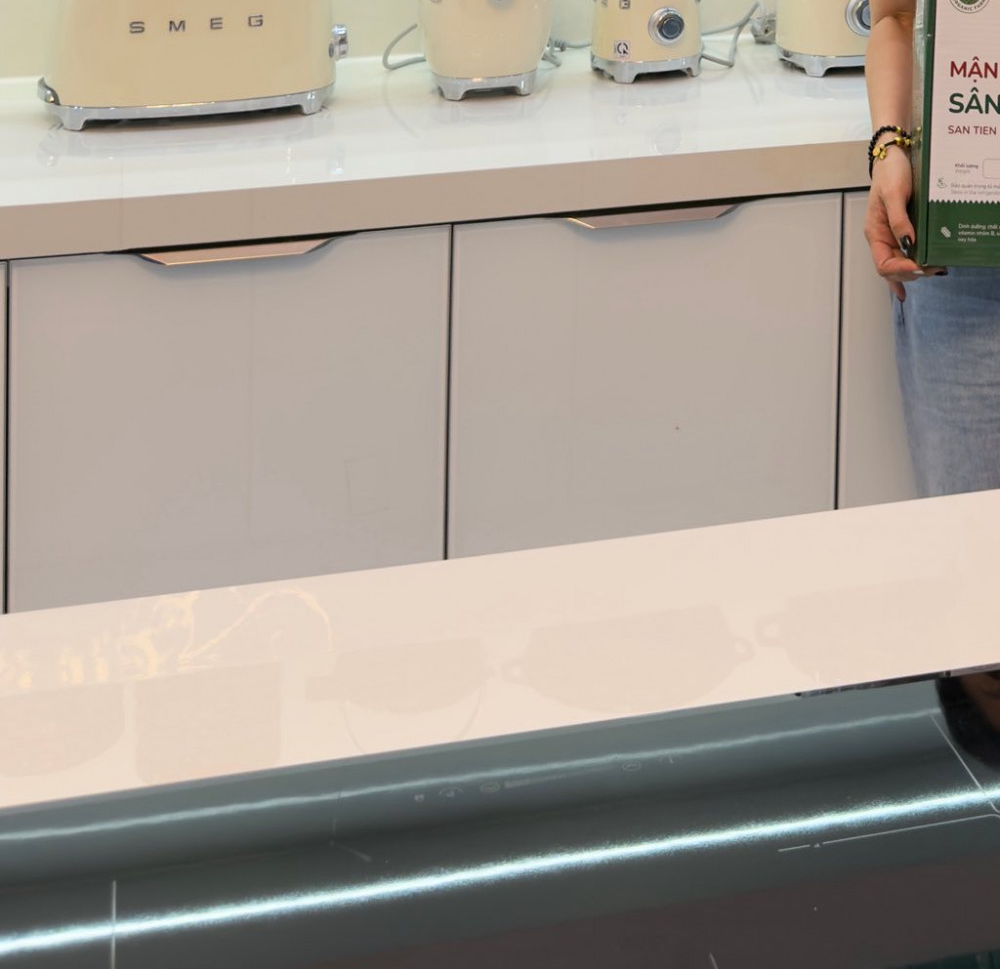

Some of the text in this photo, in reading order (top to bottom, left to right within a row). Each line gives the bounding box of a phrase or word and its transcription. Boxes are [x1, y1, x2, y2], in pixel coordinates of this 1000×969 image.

[129, 14, 264, 34] SMEG
[950, 56, 998, 83] MẬN
[948, 125, 970, 134] SAN
[973, 126, 997, 136] TIEN
